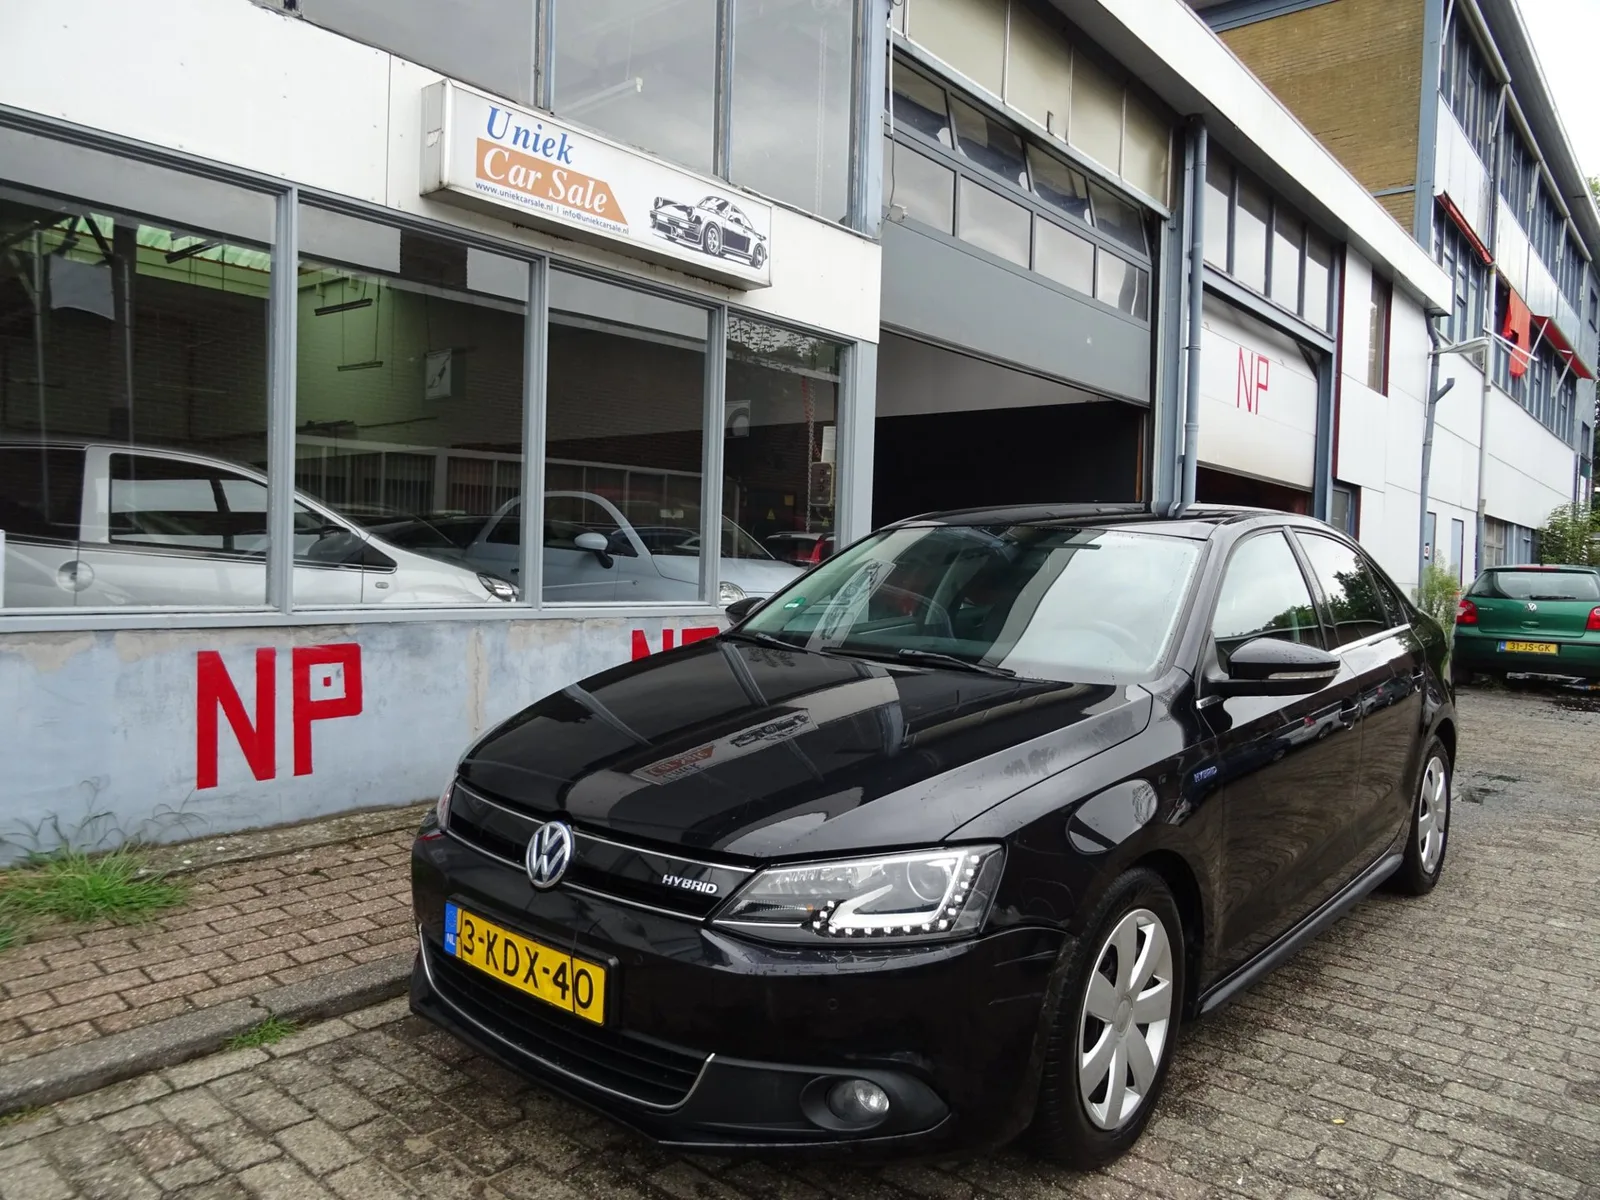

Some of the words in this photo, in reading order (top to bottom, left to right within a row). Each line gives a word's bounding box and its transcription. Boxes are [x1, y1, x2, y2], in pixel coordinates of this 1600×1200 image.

[486, 105, 574, 165] Uniek
[475, 181, 554, 212] www.uniekcarsale.nl
[562, 208, 630, 235] info@uniekcarsale.nl
[483, 148, 541, 191] Car
[549, 168, 608, 213] Sale
[1237, 346, 1269, 415] NP
[1510, 642, 1551, 652] 31-JS-GK
[197, 643, 363, 790] NP
[662, 874, 718, 894] HYBRID
[446, 932, 455, 946] NL
[462, 919, 594, 1010] 3-KDX-40
